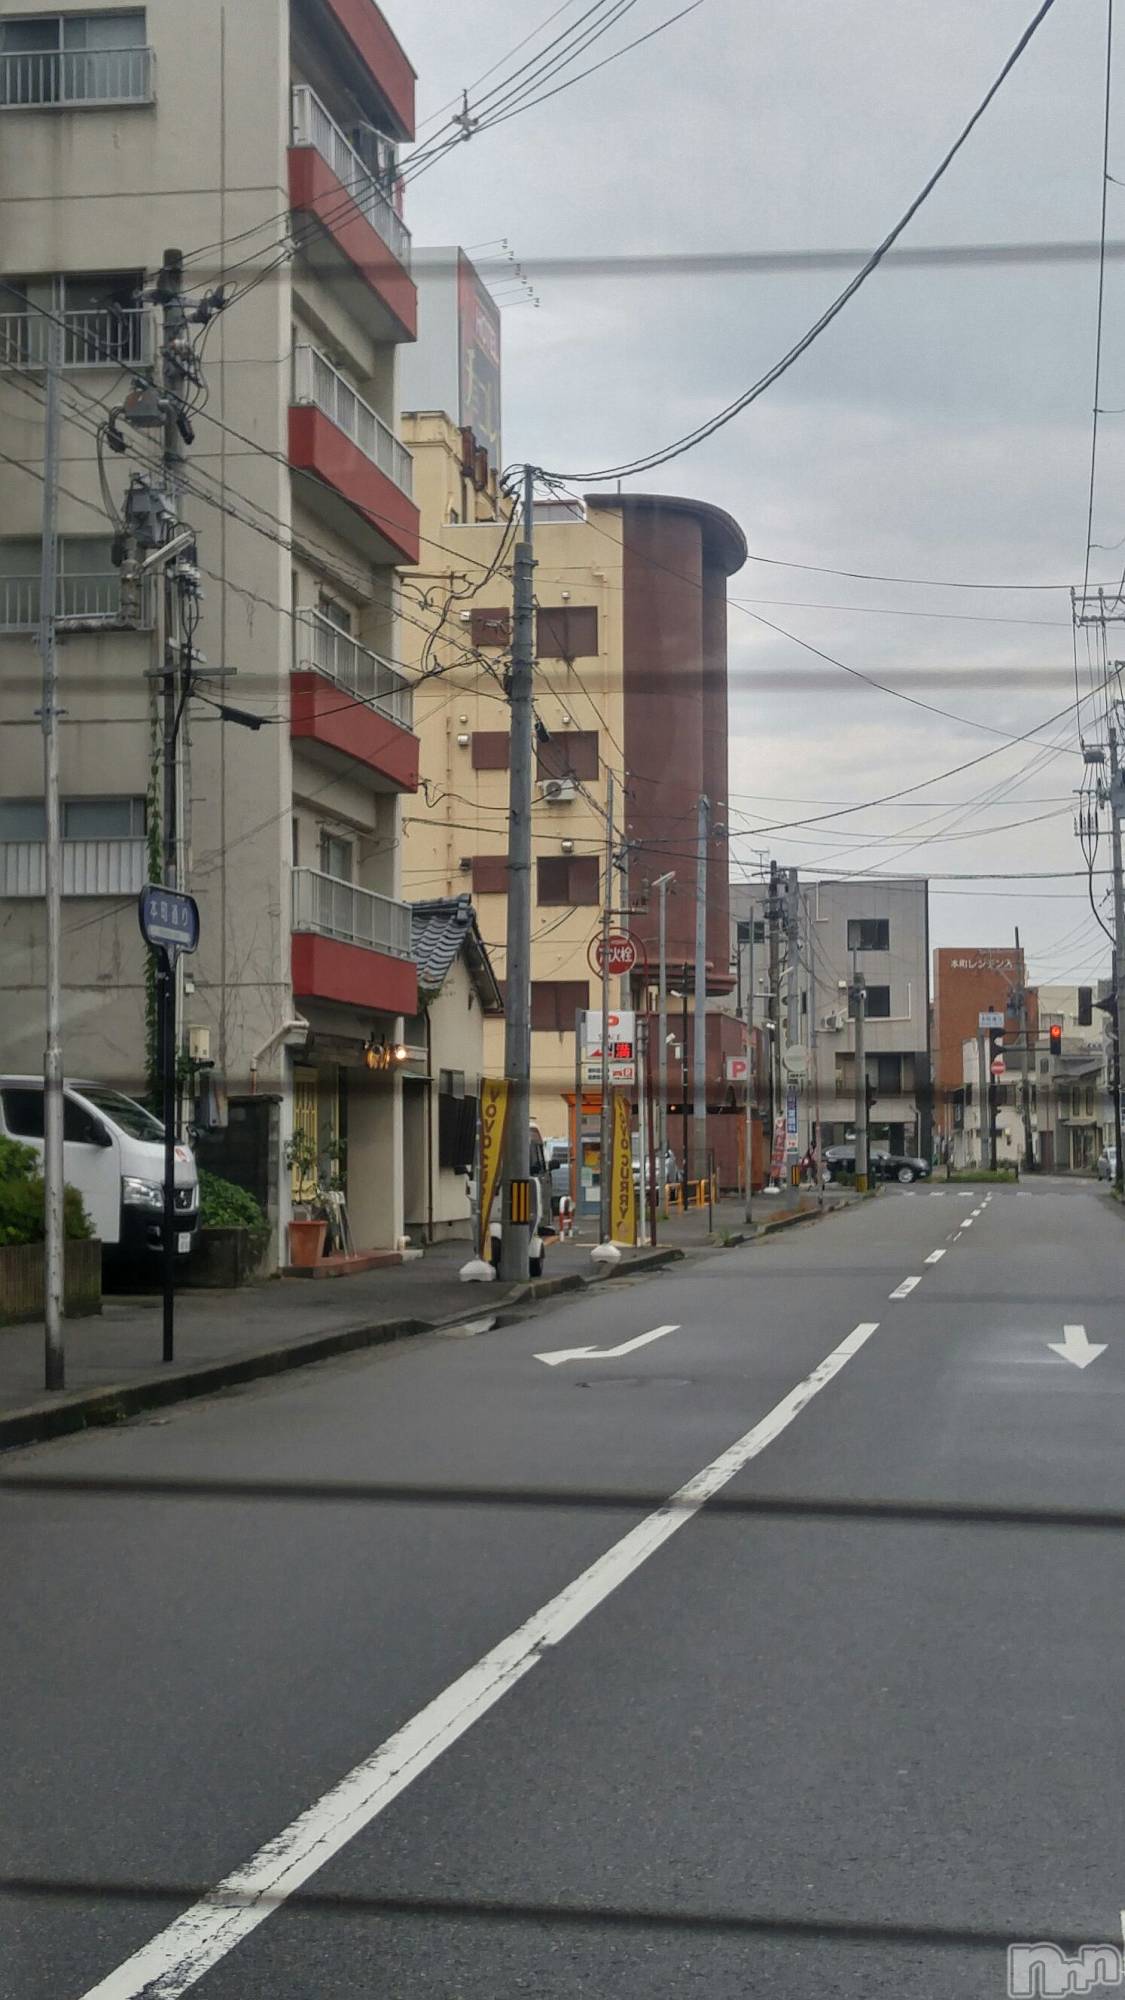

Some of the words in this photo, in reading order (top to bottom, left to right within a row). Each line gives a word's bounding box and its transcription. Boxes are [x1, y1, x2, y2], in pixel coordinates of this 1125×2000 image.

[150, 900, 188, 927] 本町通り
[732, 1061, 746, 1078] P
